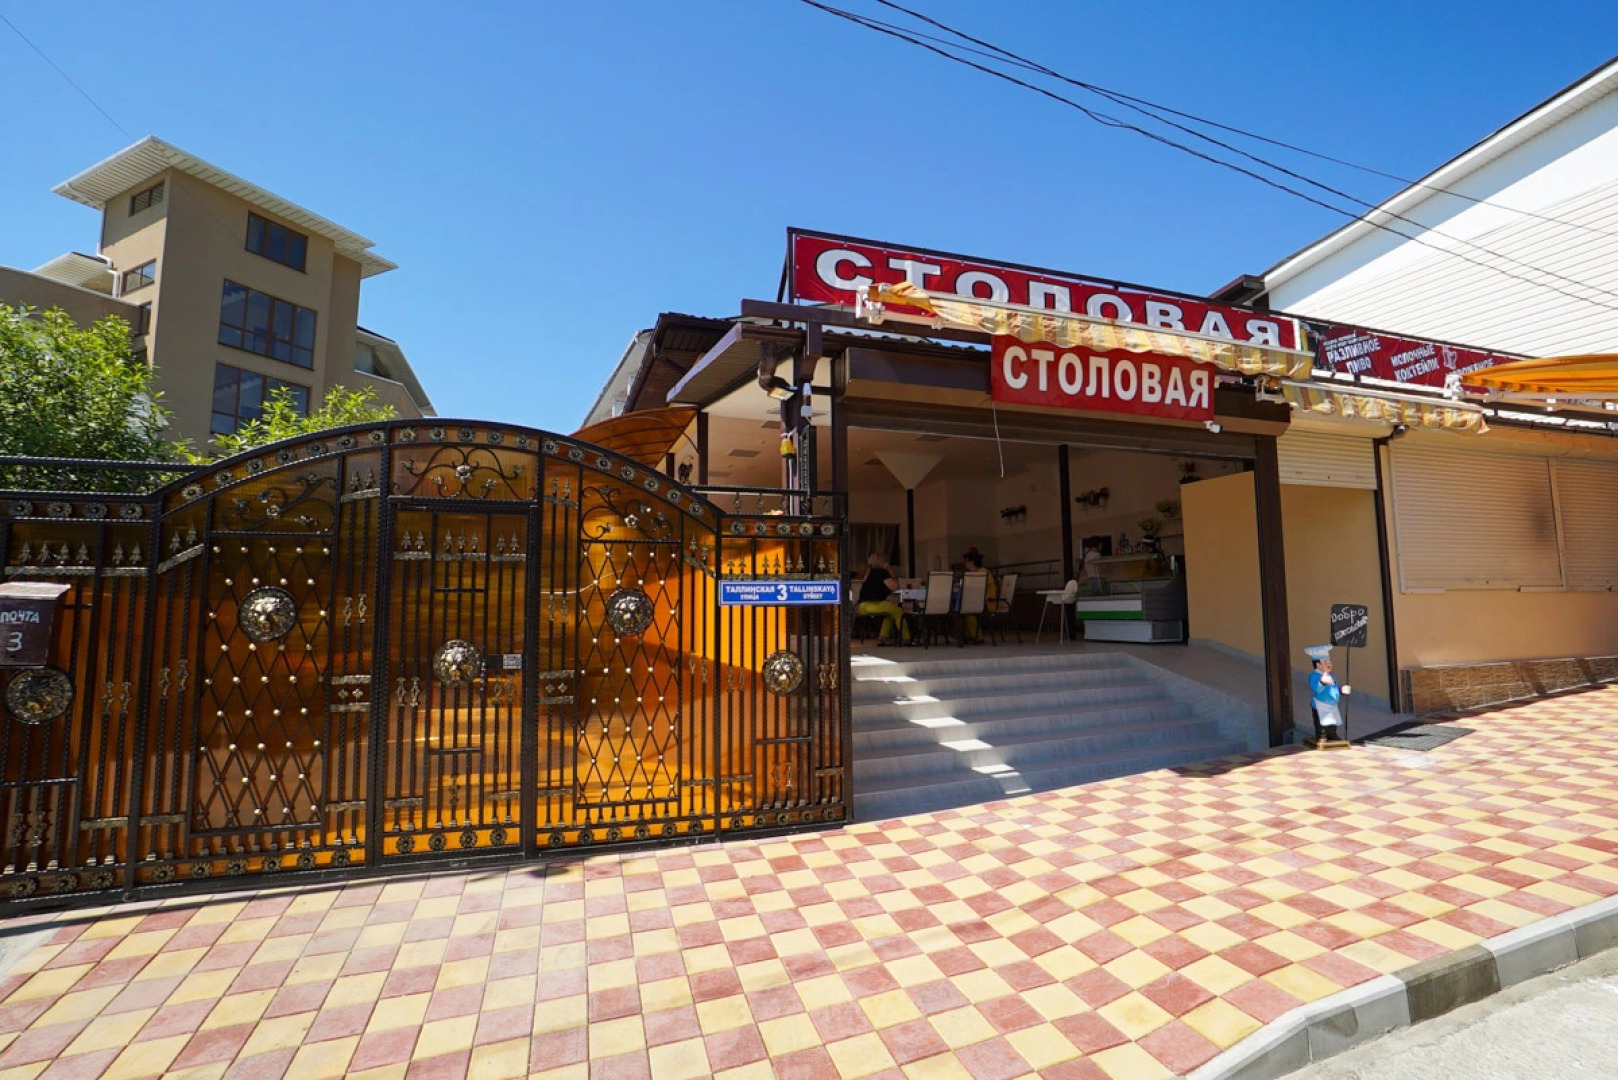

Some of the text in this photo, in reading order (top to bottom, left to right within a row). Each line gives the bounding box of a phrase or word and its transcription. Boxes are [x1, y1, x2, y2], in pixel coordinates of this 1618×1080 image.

[815, 248, 1281, 346] СТОЛОВАЯ
[1327, 338, 1381, 365] РАЗЛИВНОЕ
[1390, 344, 1435, 367] МОЛОЧНЫЕ
[1346, 356, 1371, 373] ПИВО
[1394, 358, 1440, 382] КОКТЕЙЛИ
[1003, 345, 1209, 408] СТОЛОВАЯ
[725, 585, 775, 594] ТАЛЛИНСКАЯ
[776, 584, 788, 601] 3
[789, 585, 835, 594] TALLINSKAYA
[6, 631, 23, 651] 3
